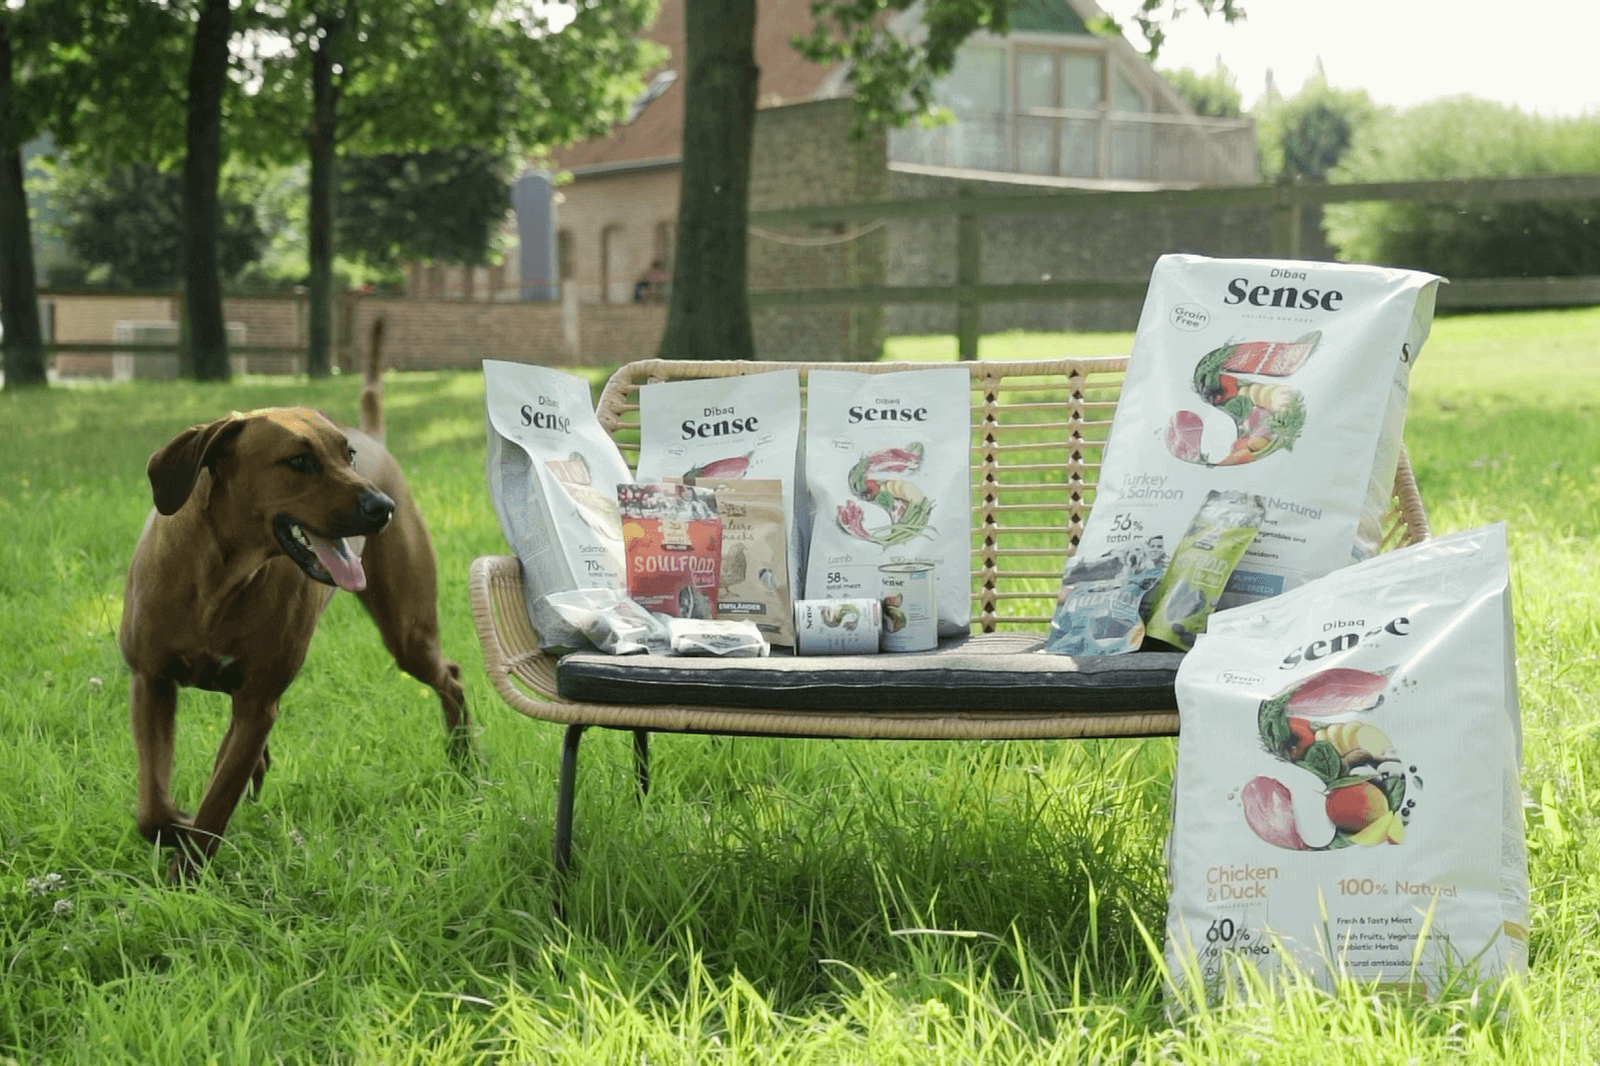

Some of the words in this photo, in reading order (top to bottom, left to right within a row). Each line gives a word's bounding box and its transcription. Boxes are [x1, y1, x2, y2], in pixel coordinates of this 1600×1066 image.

[1270, 268, 1307, 281] Dibaq
[1223, 277, 1343, 312] Sense
[1174, 306, 1207, 322] Grain
[1175, 315, 1200, 328] Free
[875, 397, 901, 405] Dibaq
[520, 404, 572, 434] Sense
[703, 406, 735, 418] Dibaq
[847, 405, 928, 424] Sense
[681, 416, 760, 441] Sense
[1123, 472, 1169, 489] Turkey
[1126, 485, 1184, 500] Salmon
[1267, 496, 1323, 521] Natural
[1110, 512, 1144, 532] 56%
[1106, 532, 1132, 543] total
[634, 555, 716, 573] SOULFOOD
[827, 553, 854, 565] Lamb
[1323, 618, 1366, 631] Dibaq
[1206, 864, 1278, 884] Chicken
[1206, 887, 1218, 903] &
[1220, 881, 1266, 901] Duck
[1337, 878, 1389, 896] 100%
[1394, 880, 1458, 898] Natural
[1336, 917, 1358, 925] Fresh
[1367, 917, 1389, 926] Tasty
[1205, 918, 1251, 943] 60%
[1374, 943, 1399, 951] Herbs
